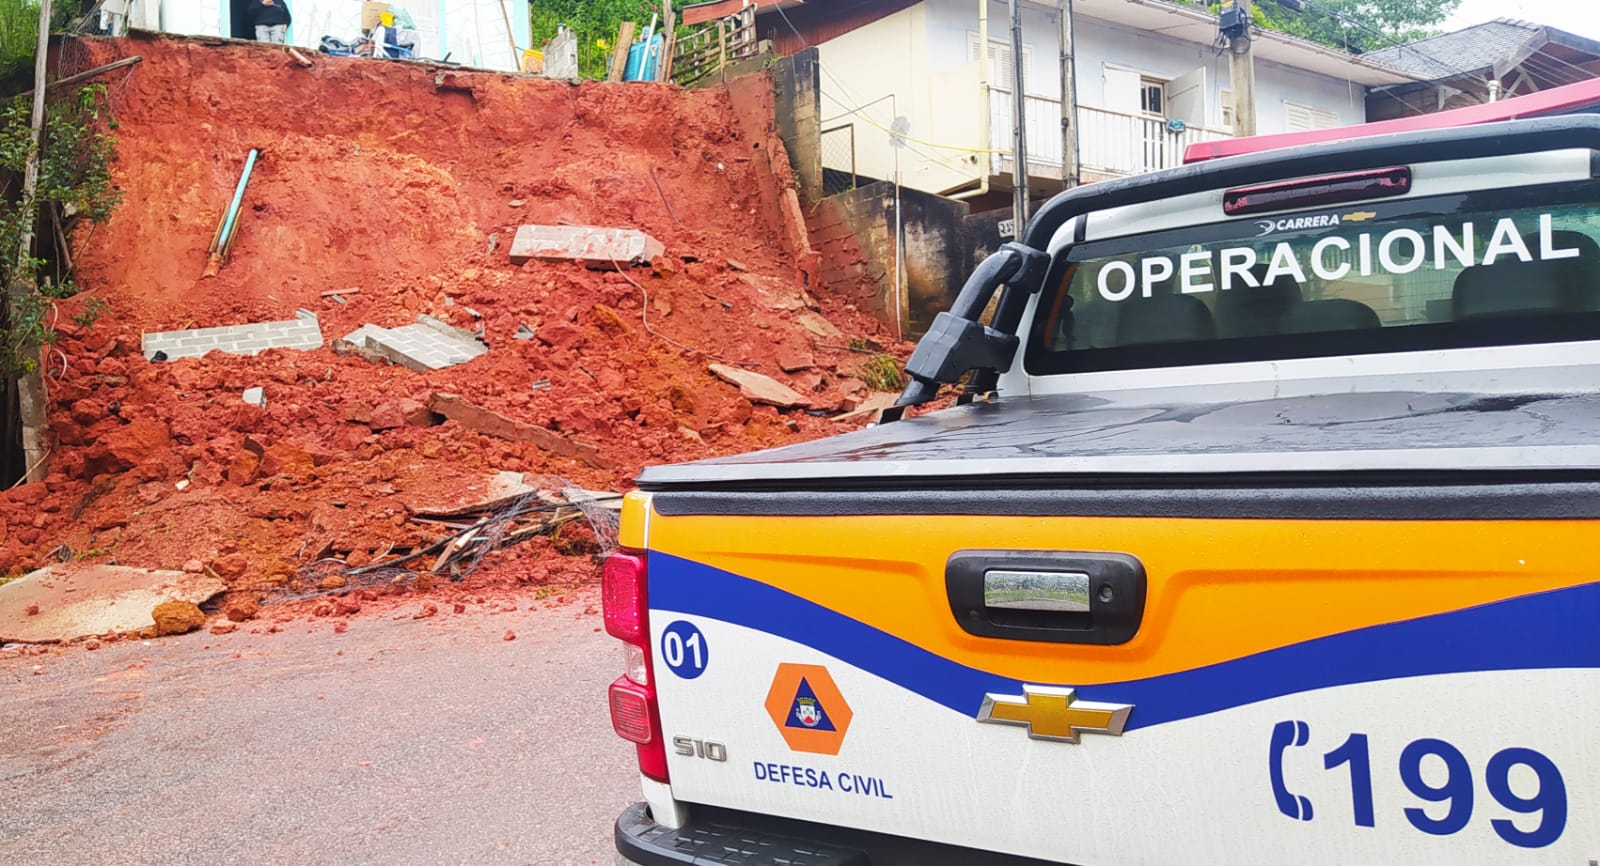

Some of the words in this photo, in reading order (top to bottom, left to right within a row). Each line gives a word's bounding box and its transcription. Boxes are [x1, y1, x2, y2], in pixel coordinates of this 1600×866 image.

[1277, 214, 1340, 231] CARRERA
[1097, 213, 1580, 302] OPERACIONAL
[664, 632, 704, 669] 01
[673, 736, 727, 762] S10
[754, 762, 833, 790] DEFESA
[838, 773, 893, 799] CIVIL
[1323, 732, 1568, 848] 199
